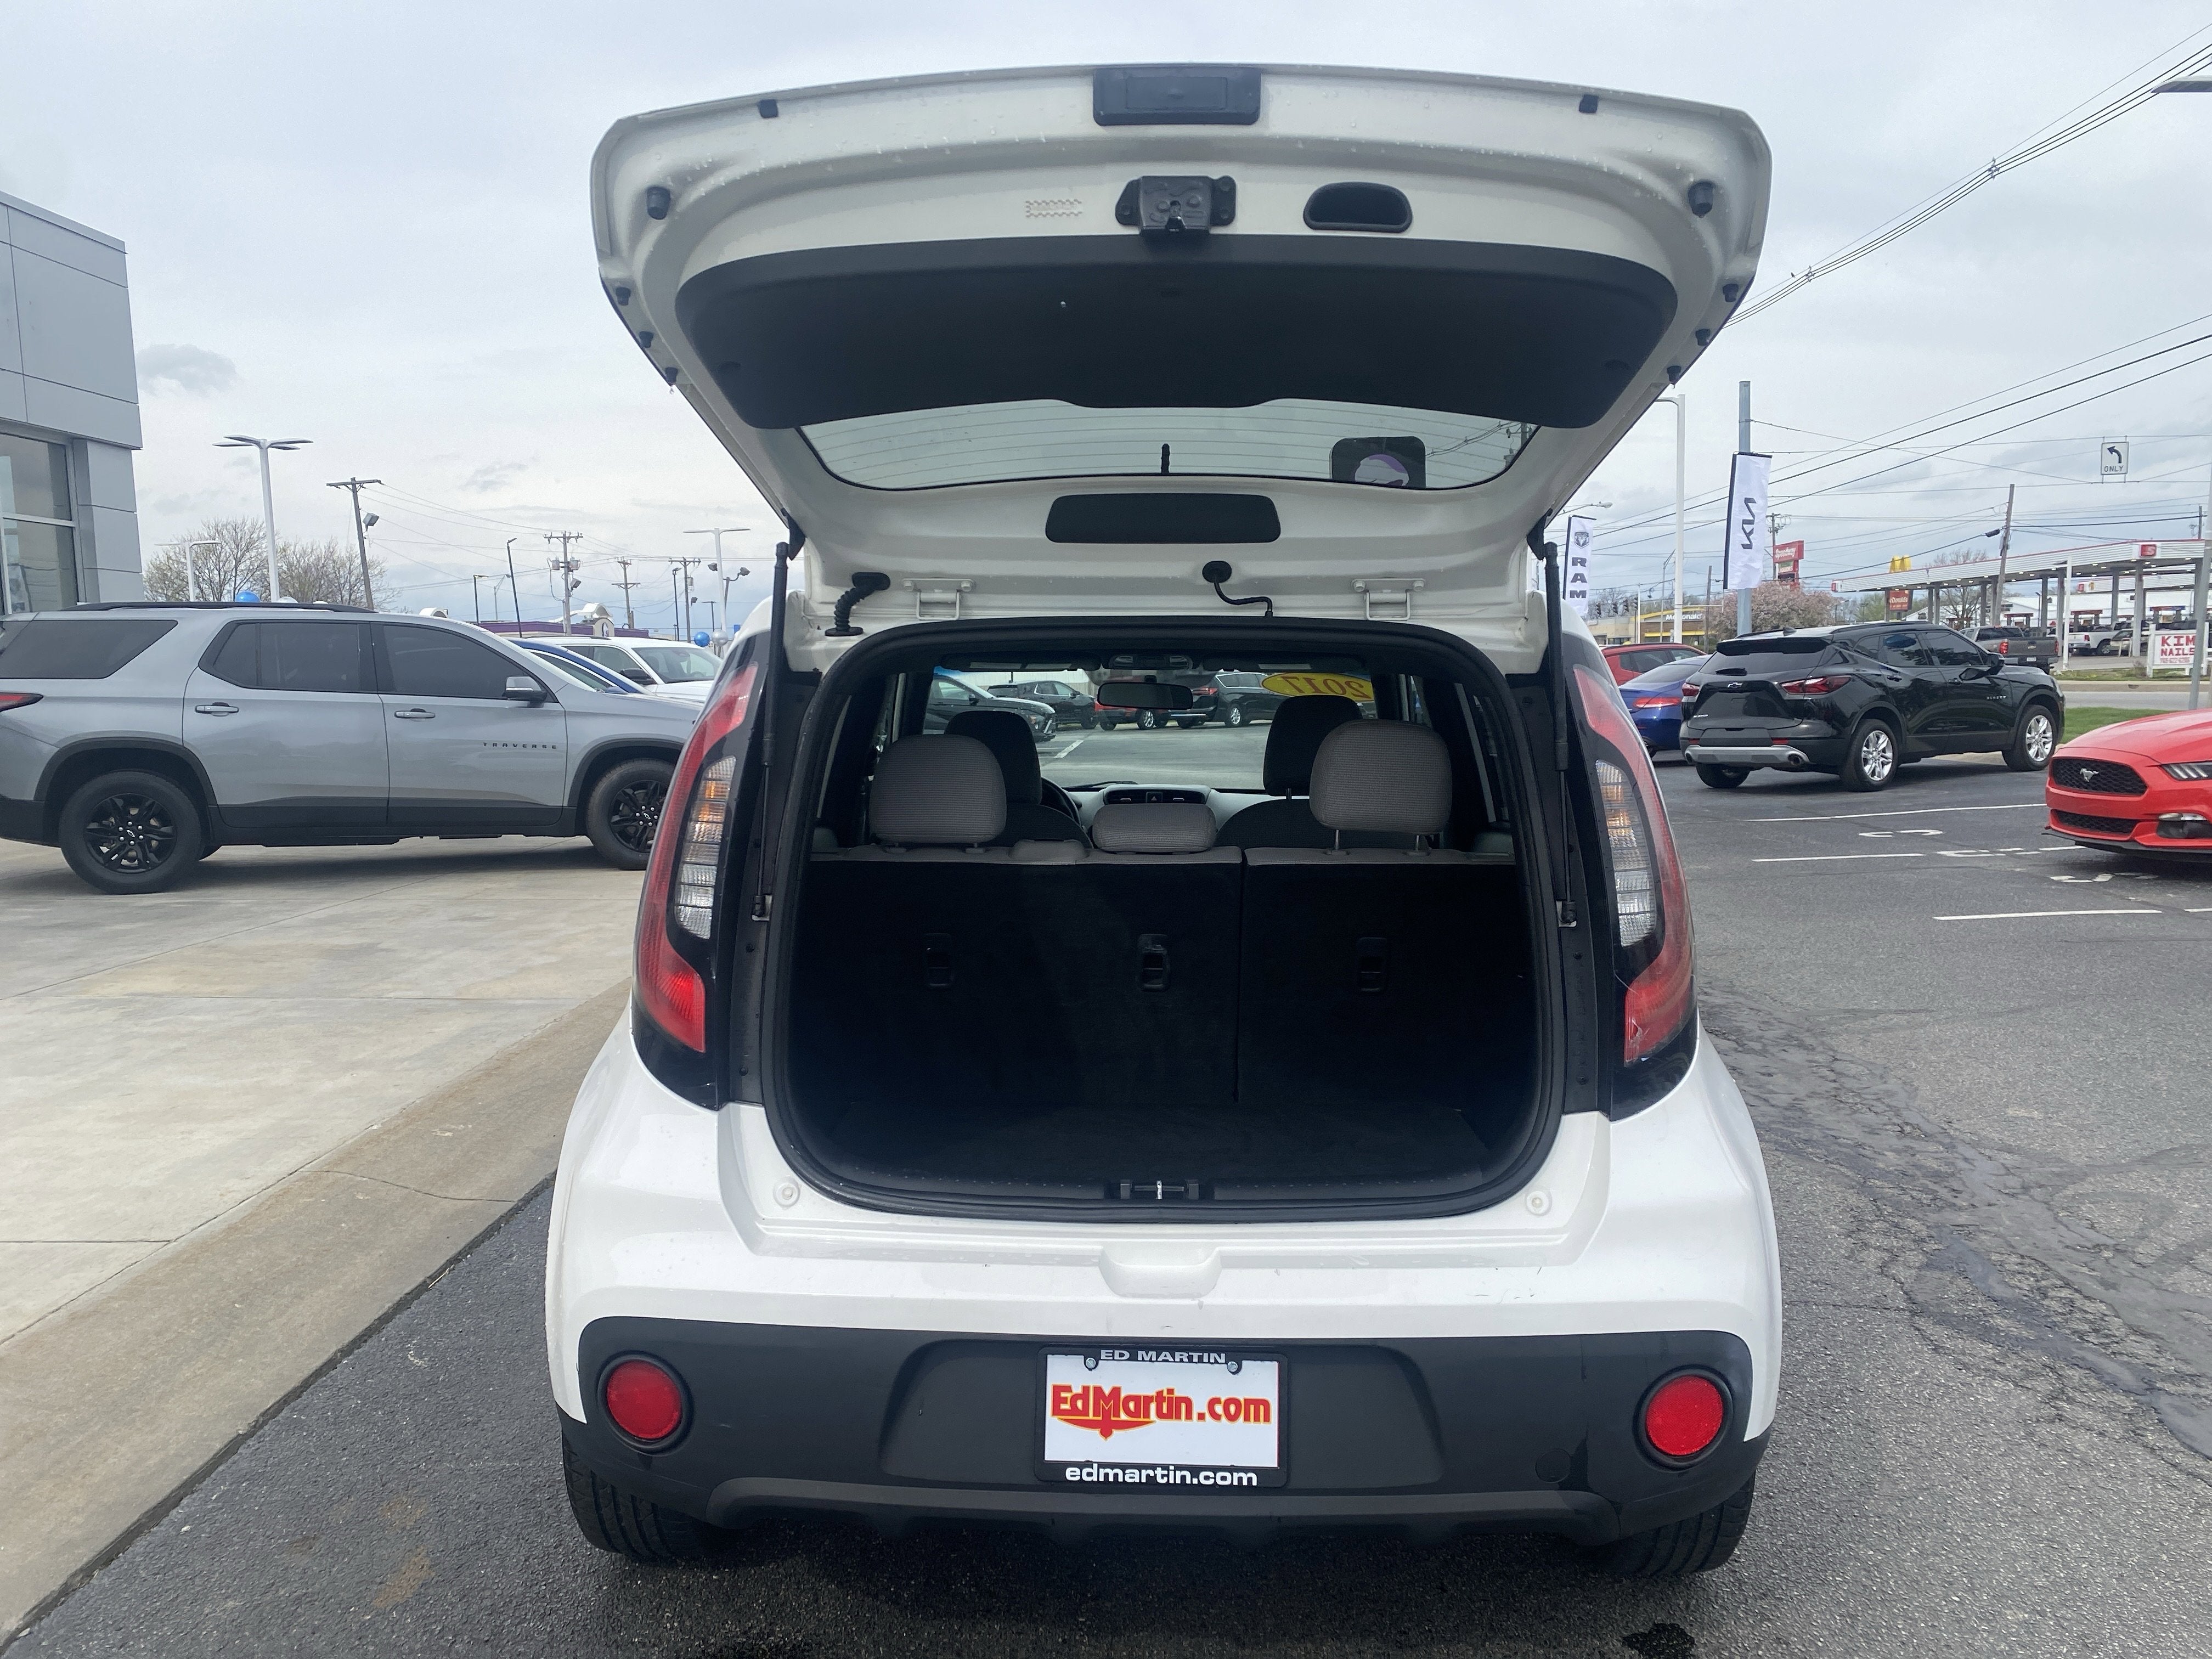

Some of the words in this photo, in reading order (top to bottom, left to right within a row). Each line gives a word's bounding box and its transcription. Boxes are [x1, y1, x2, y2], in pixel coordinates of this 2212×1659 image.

[1570, 557, 1588, 599] RAM
[2161, 635, 2196, 646] KIM
[2160, 647, 2195, 656] NAILS
[1101, 1350, 1130, 1361] ED
[1137, 1350, 1226, 1363] MARTIN
[1051, 1384, 1272, 1425] EdMartin.com
[1065, 1463, 1257, 1486] edmartin.com
